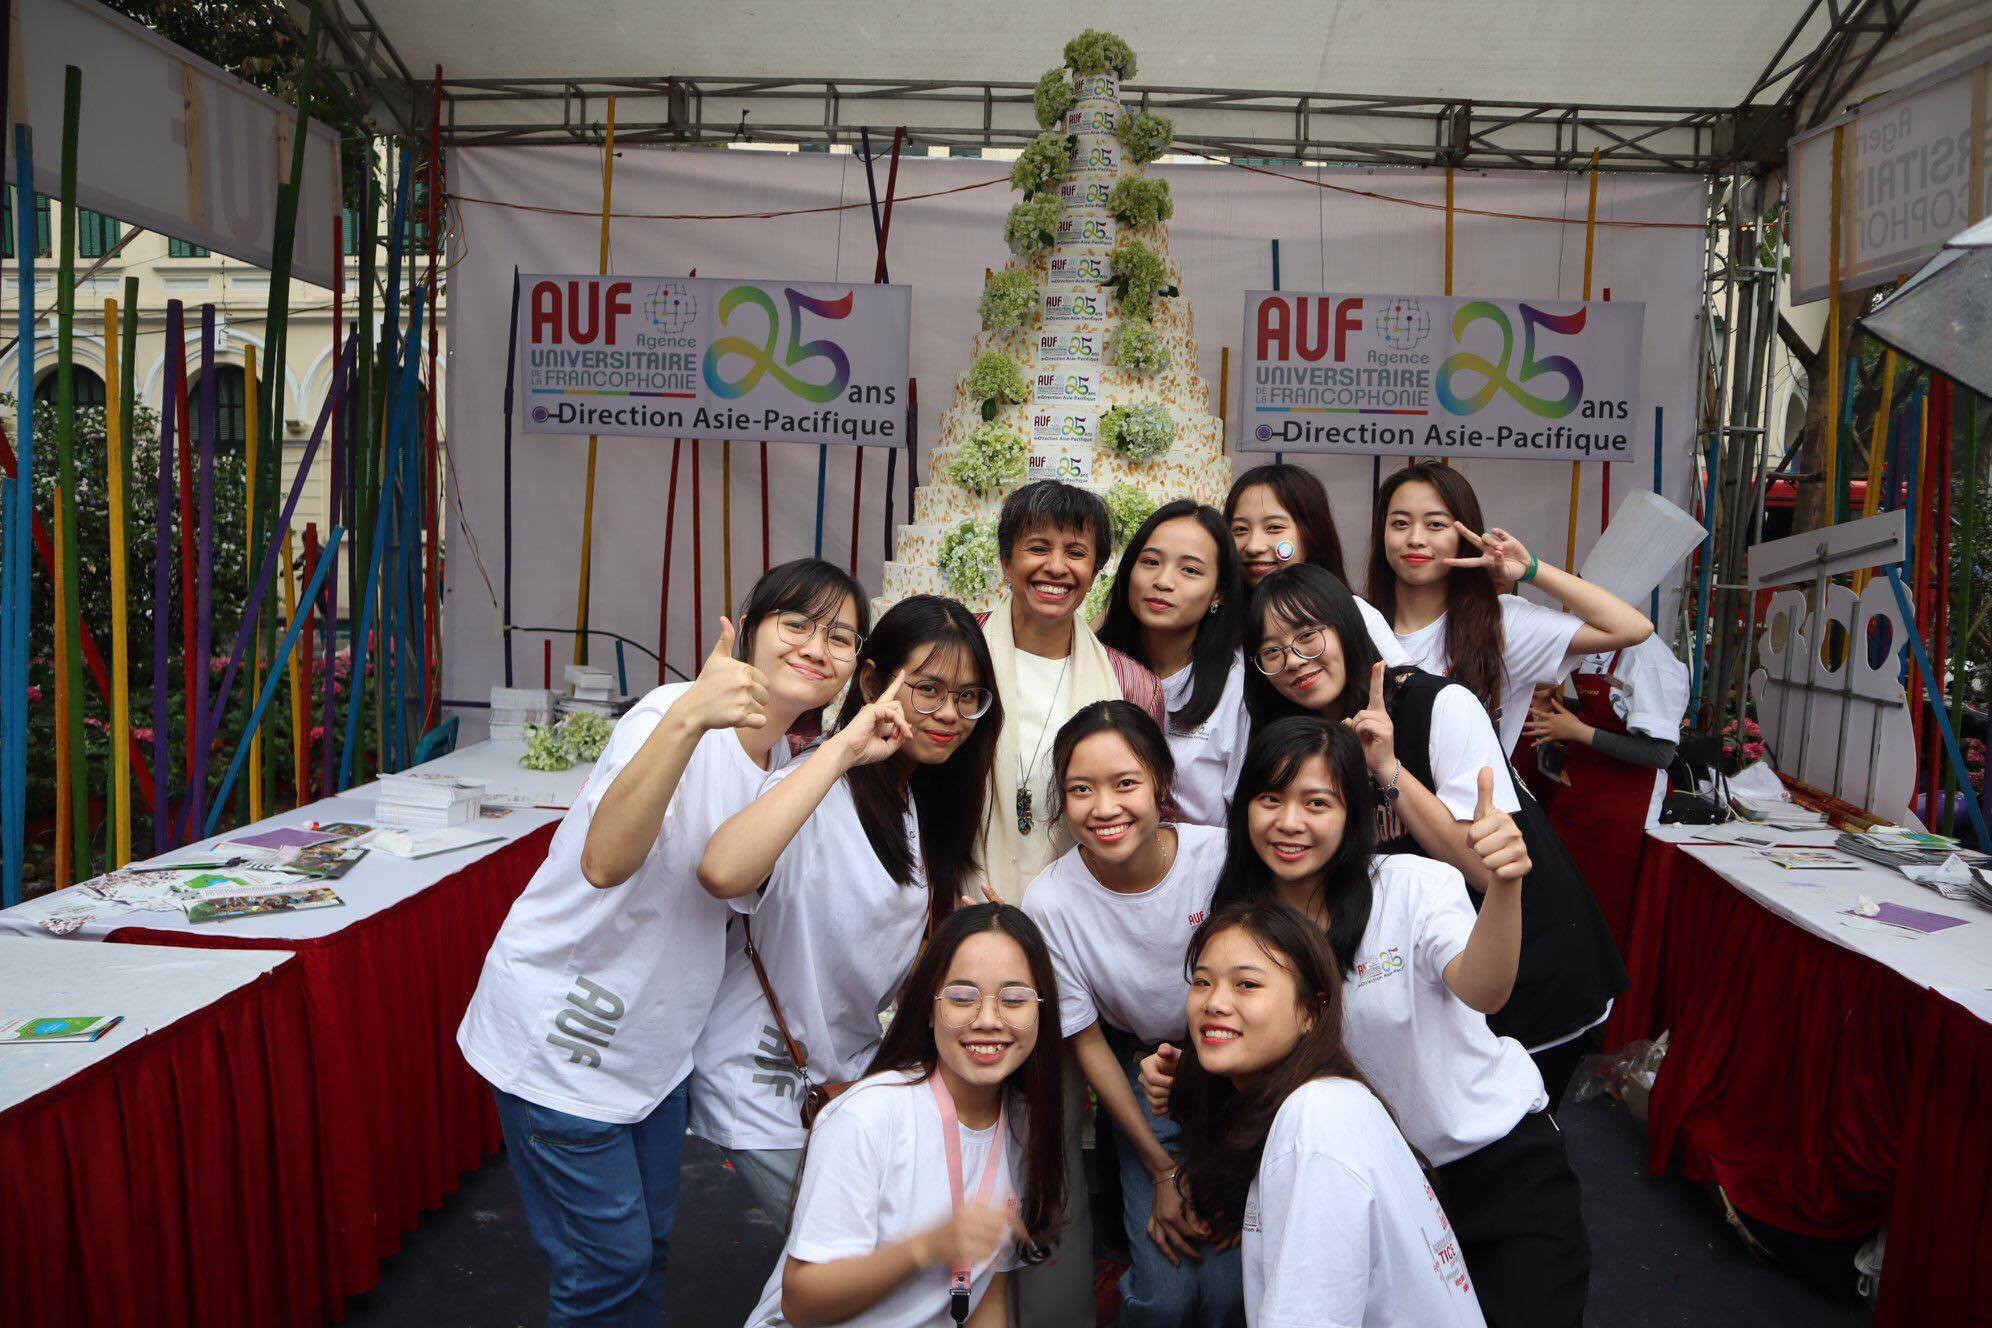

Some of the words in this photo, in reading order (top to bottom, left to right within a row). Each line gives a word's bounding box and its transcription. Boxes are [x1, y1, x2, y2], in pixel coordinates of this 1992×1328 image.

[1094, 78, 1114, 98] 25
[1091, 111, 1114, 131] 25
[1088, 148, 1112, 167] 25
[1061, 184, 1076, 197] AUF
[1086, 184, 1110, 202] 25
[1082, 220, 1106, 240] 25
[1052, 258, 1068, 271] AUF
[1078, 258, 1102, 278] 25
[1046, 296, 1062, 308] AUF
[1072, 296, 1096, 316] 25
[531, 280, 632, 345] AUF
[1256, 296, 1364, 362] AUF
[636, 333, 696, 350] Agence
[703, 285, 854, 404] 25
[1042, 336, 1058, 348] AUF
[1068, 336, 1092, 356] 25
[531, 349, 697, 372] UNIVERSITAIRE
[1368, 350, 1430, 366] Agence
[1435, 301, 1586, 419] 25
[546, 370, 697, 390] FRANCOPHONIE
[1038, 375, 1054, 386] AUF
[1065, 376, 1090, 396] 25
[1256, 366, 1430, 388] UNIVERSITAIRE
[848, 382, 896, 405] ans
[1270, 387, 1430, 406] FRANCOPHONIE
[1581, 400, 1628, 420] ans
[558, 403, 683, 428] Direction
[693, 407, 894, 440] Asie-Pacifique
[1034, 416, 1051, 427] AUF
[1061, 416, 1086, 436] 25
[1283, 421, 1414, 445] Direction
[1424, 424, 1627, 456] Asie-Pacifique
[1029, 456, 1046, 468] AUF
[1057, 457, 1082, 477] 25
[1188, 911, 1204, 926] AUF
[545, 975, 626, 1069] AUF
